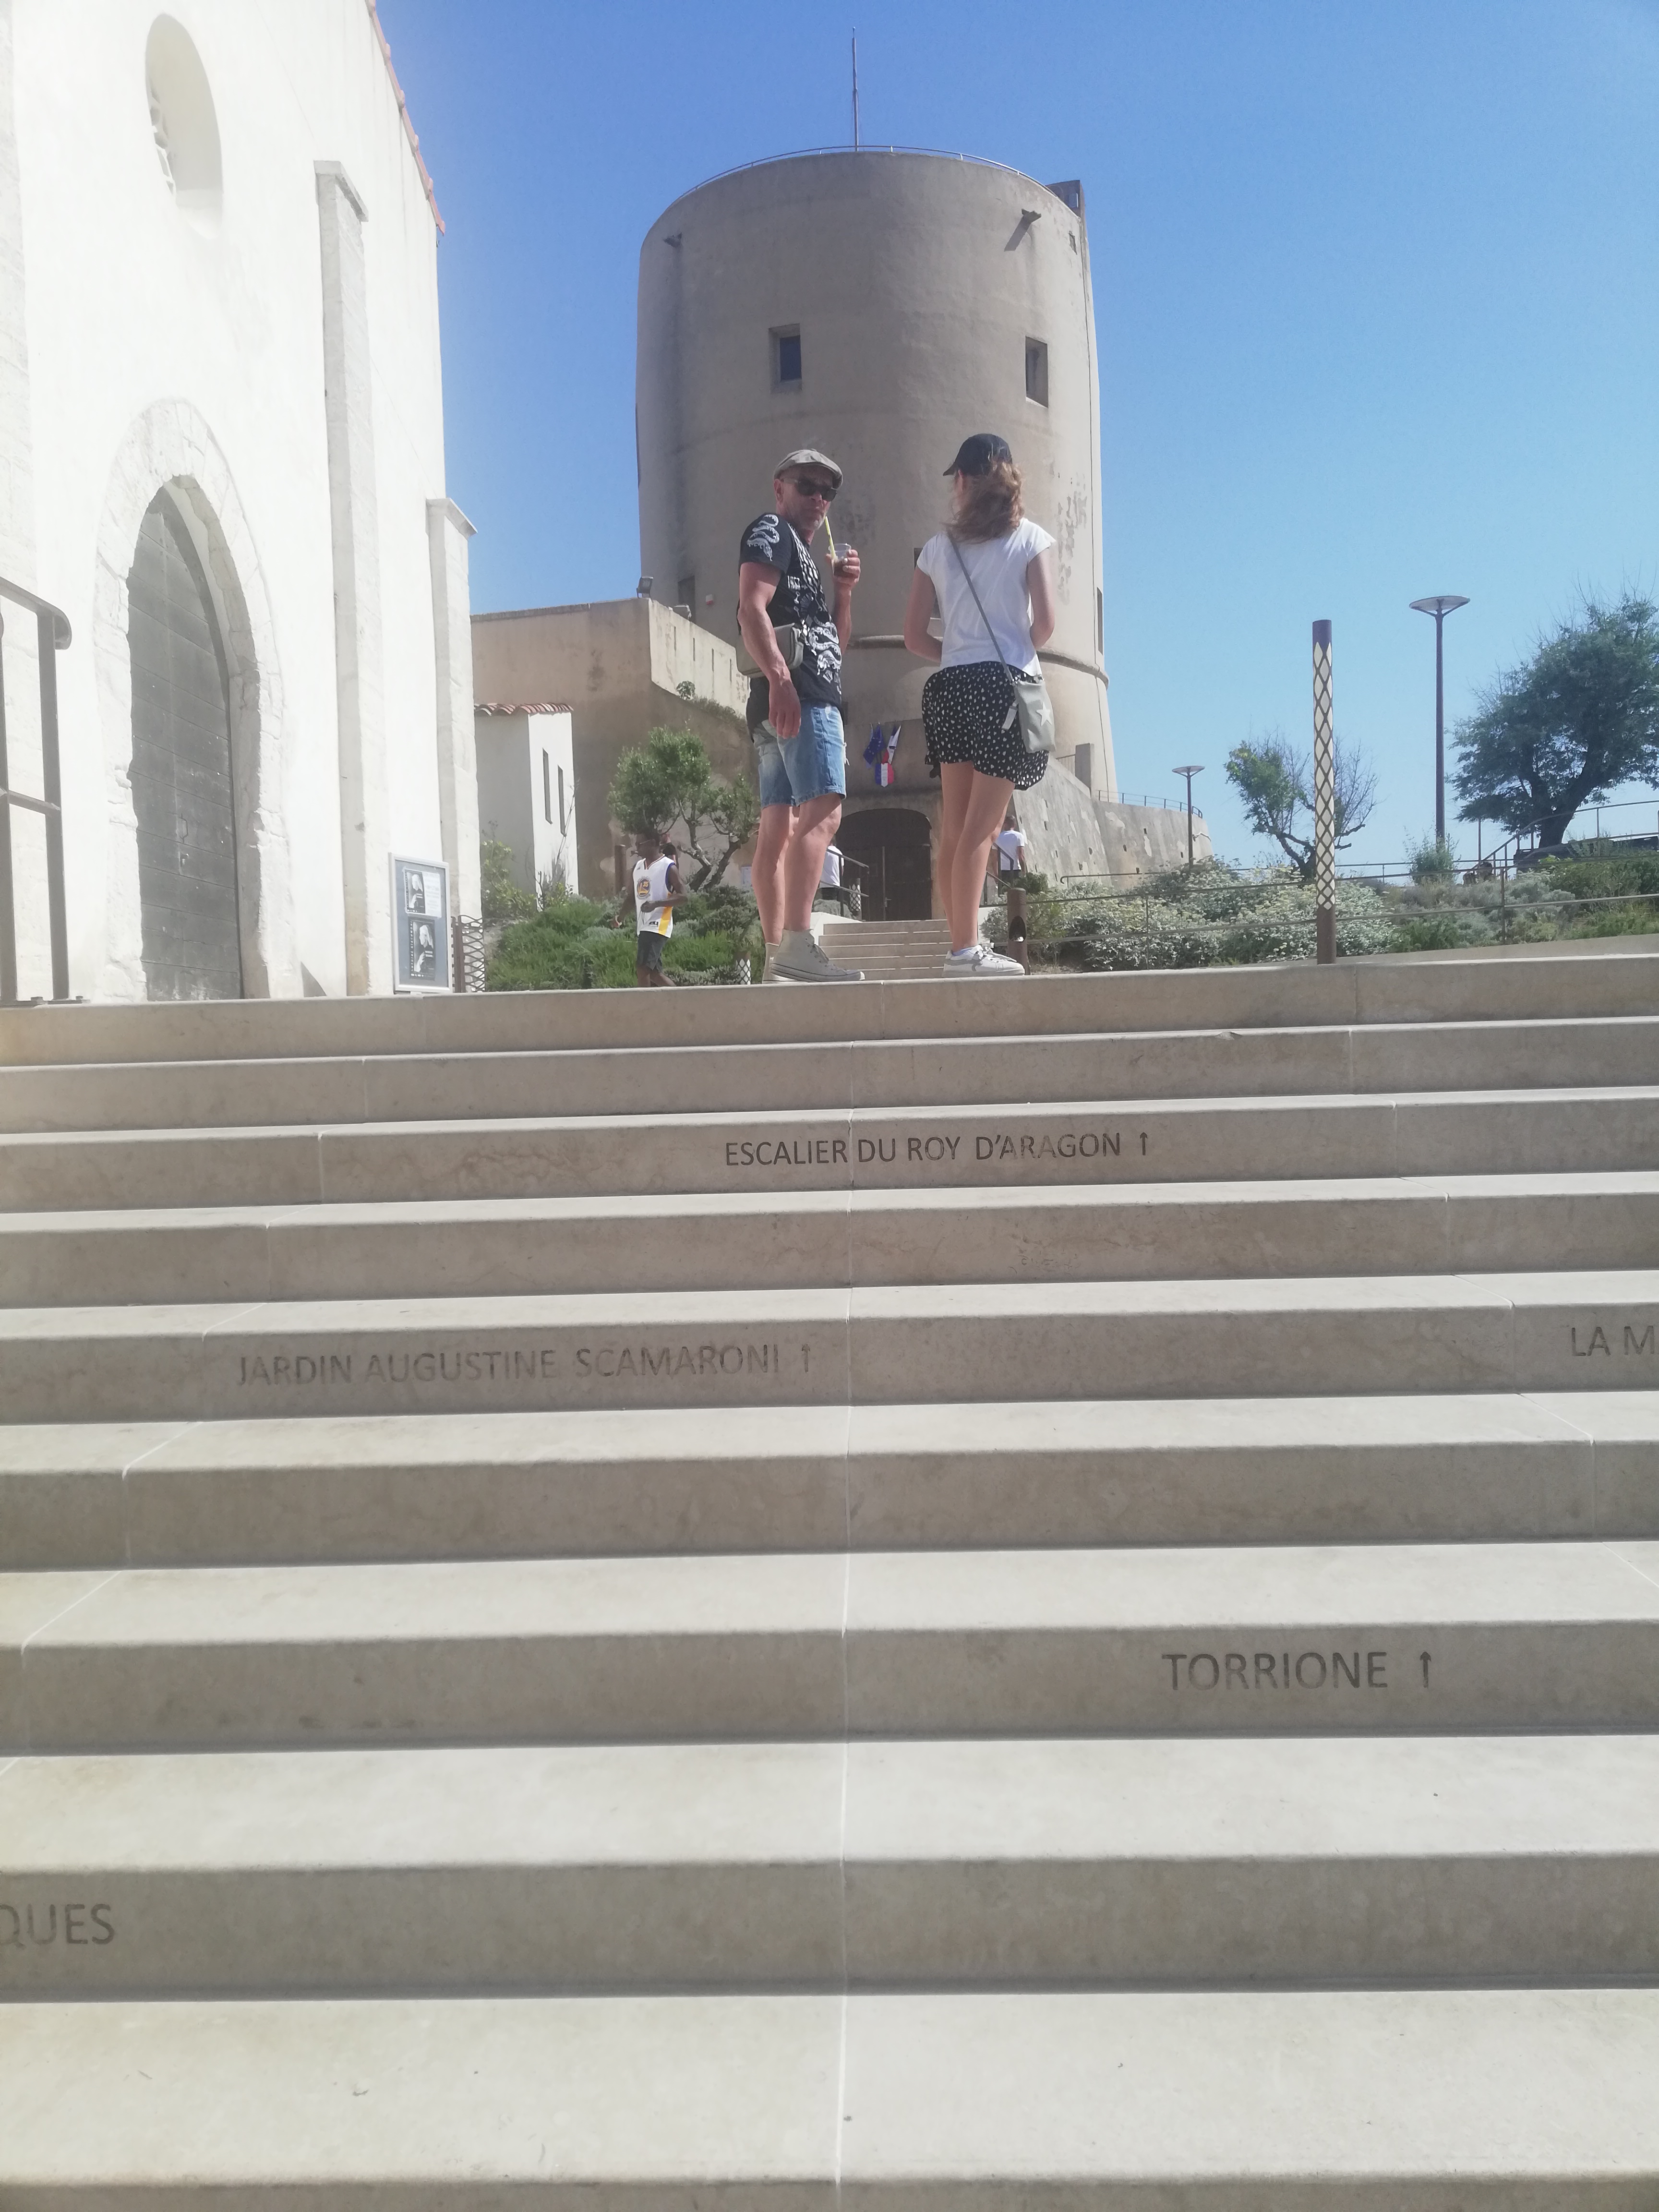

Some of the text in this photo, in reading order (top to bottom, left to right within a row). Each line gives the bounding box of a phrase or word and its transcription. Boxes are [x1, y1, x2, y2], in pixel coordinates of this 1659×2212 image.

[726, 1132, 1120, 1166] ESCALIER DU ROY D'ARAGON
[1572, 1327, 1611, 1357] LA
[239, 1344, 779, 1385] JARDIN AUGUSTINE SCAMARONI
[1161, 1651, 1388, 1690] TORRIONE
